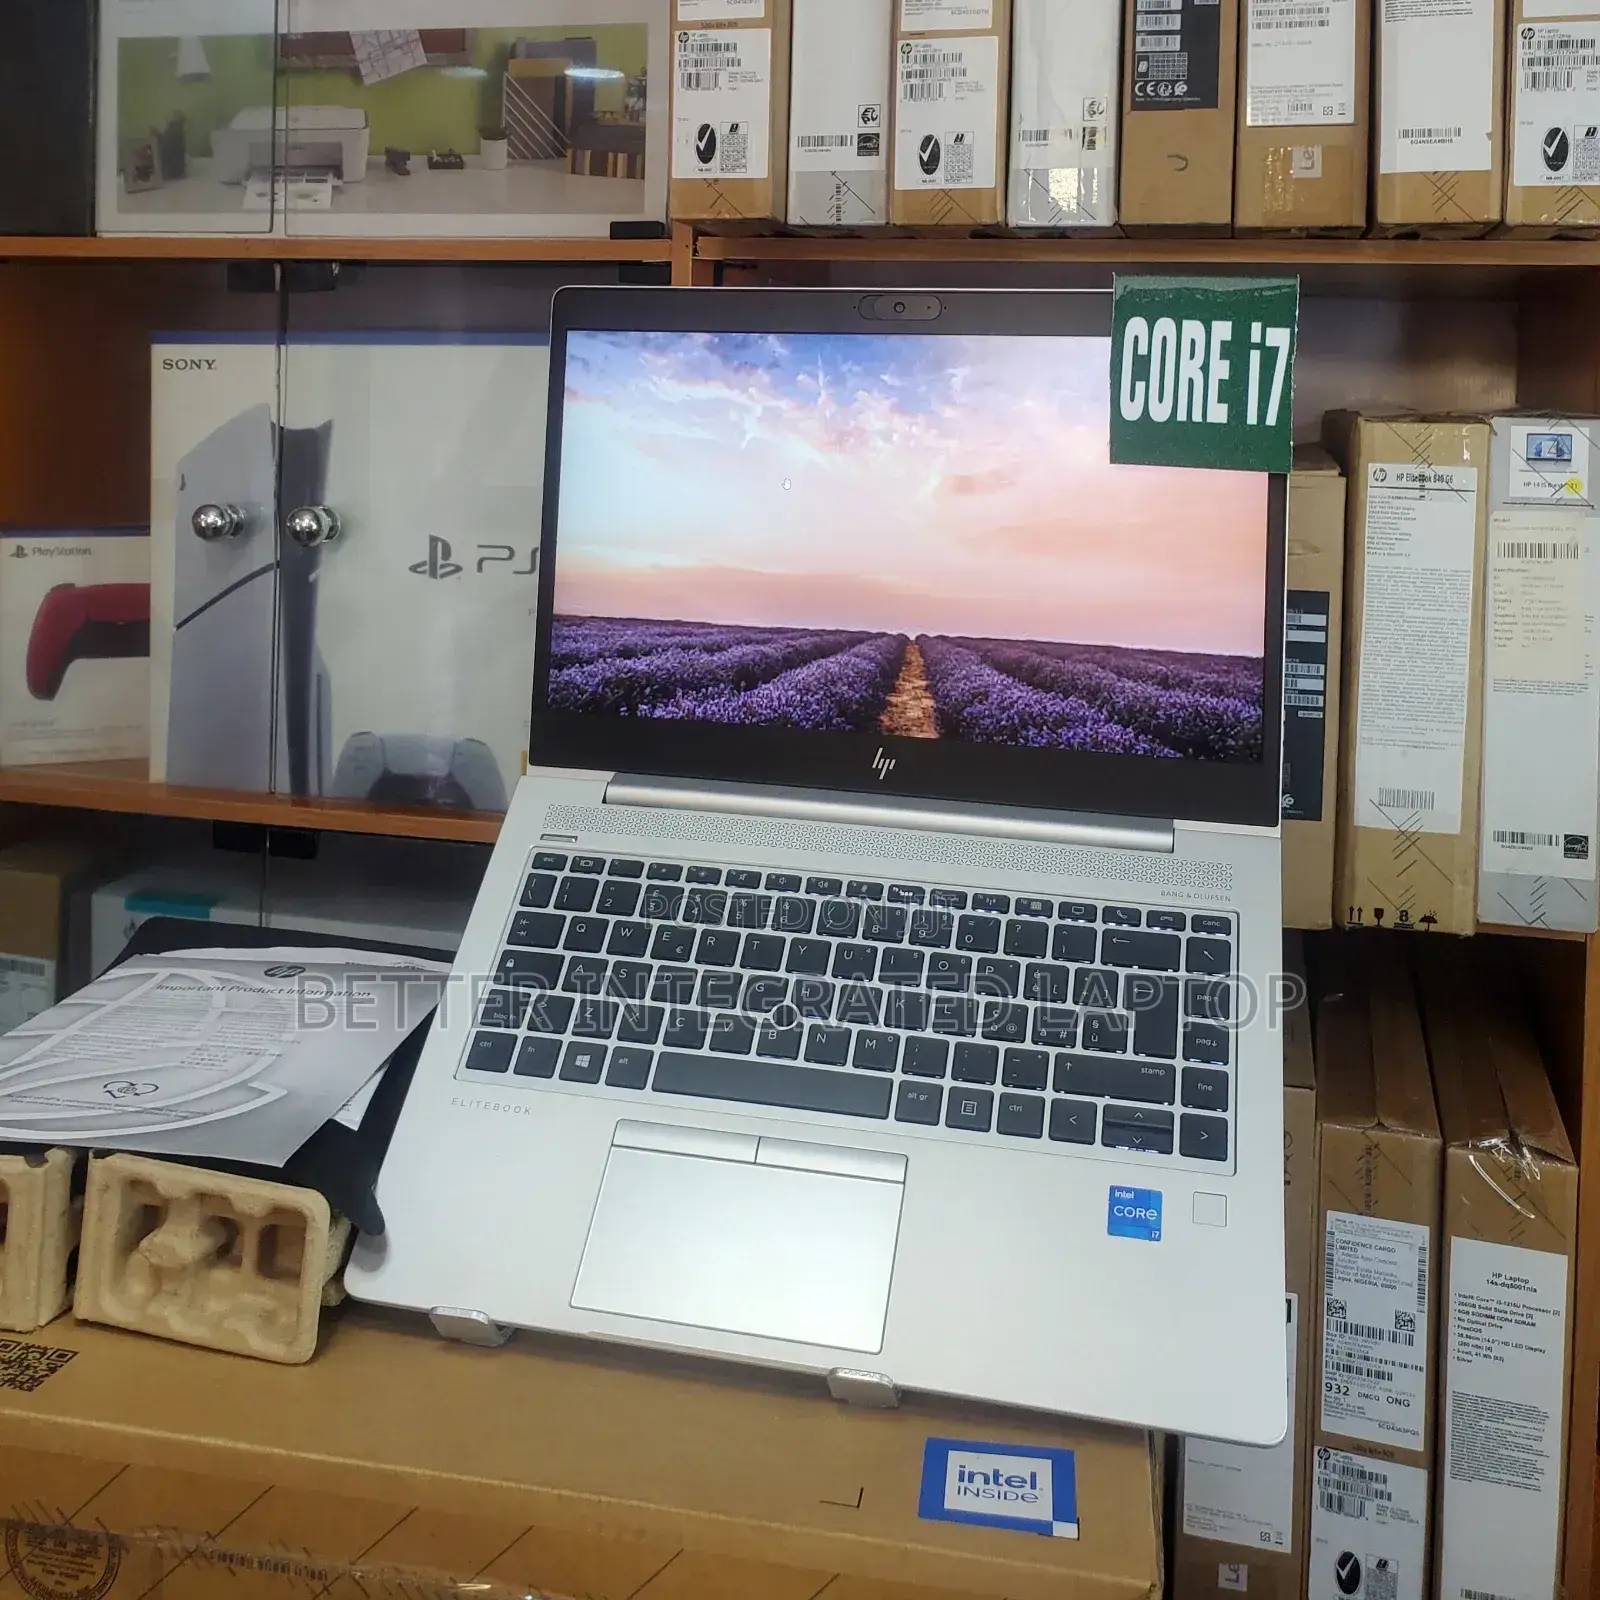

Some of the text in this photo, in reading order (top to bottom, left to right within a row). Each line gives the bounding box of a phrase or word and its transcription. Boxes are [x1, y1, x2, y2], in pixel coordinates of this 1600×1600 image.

[162, 358, 217, 371] SONY
[1119, 316, 1291, 426] CORE i7
[1396, 472, 1405, 482] HP
[32, 546, 92, 558] PlayStation
[872, 747, 896, 780] hp
[1160, 889, 1184, 899] BANG
[1193, 892, 1232, 902] OLUFSEN
[604, 898, 613, 908] 2
[576, 923, 587, 934] Q
[1202, 919, 1221, 928] canc
[620, 927, 634, 938] W
[872, 925, 881, 934] 8
[662, 931, 672, 941] E
[706, 936, 716, 946] R
[752, 941, 761, 950] T
[798, 945, 808, 955] Y
[844, 950, 853, 960] U
[575, 964, 585, 975] A
[618, 968, 628, 978] S
[985, 965, 994, 975] P
[663, 973, 673, 983] D
[156, 983, 372, 998] Important Product Information
[755, 983, 765, 992] G
[801, 987, 810, 997] H
[675, 1017, 686, 1028] C
[768, 1029, 777, 1040] B
[816, 1033, 827, 1044] N
[479, 1039, 493, 1048] ctrl
[865, 1038, 877, 1049] M
[1195, 1037, 1211, 1047] pag
[618, 1056, 629, 1065] alt
[1140, 1065, 1166, 1077] stamp
[1197, 1082, 1213, 1092] fine
[906, 1090, 918, 1100] alt
[451, 1097, 533, 1116] ELITEBOOK
[1008, 1103, 1023, 1113] ctrl
[1114, 1189, 1135, 1200] intel
[1151, 1230, 1160, 1239] i7
[1335, 1238, 1397, 1254] CONFIDENCE CARGO
[1335, 1245, 1359, 1253] LIMITED
[1491, 1271, 1530, 1284] HP Laptop
[1522, 1304, 1551, 1315] Processor
[1525, 1344, 1546, 1354] Display
[1324, 1381, 1350, 1397] 932
[1386, 1395, 1411, 1408] ONG
[957, 1464, 1038, 1491] intel
